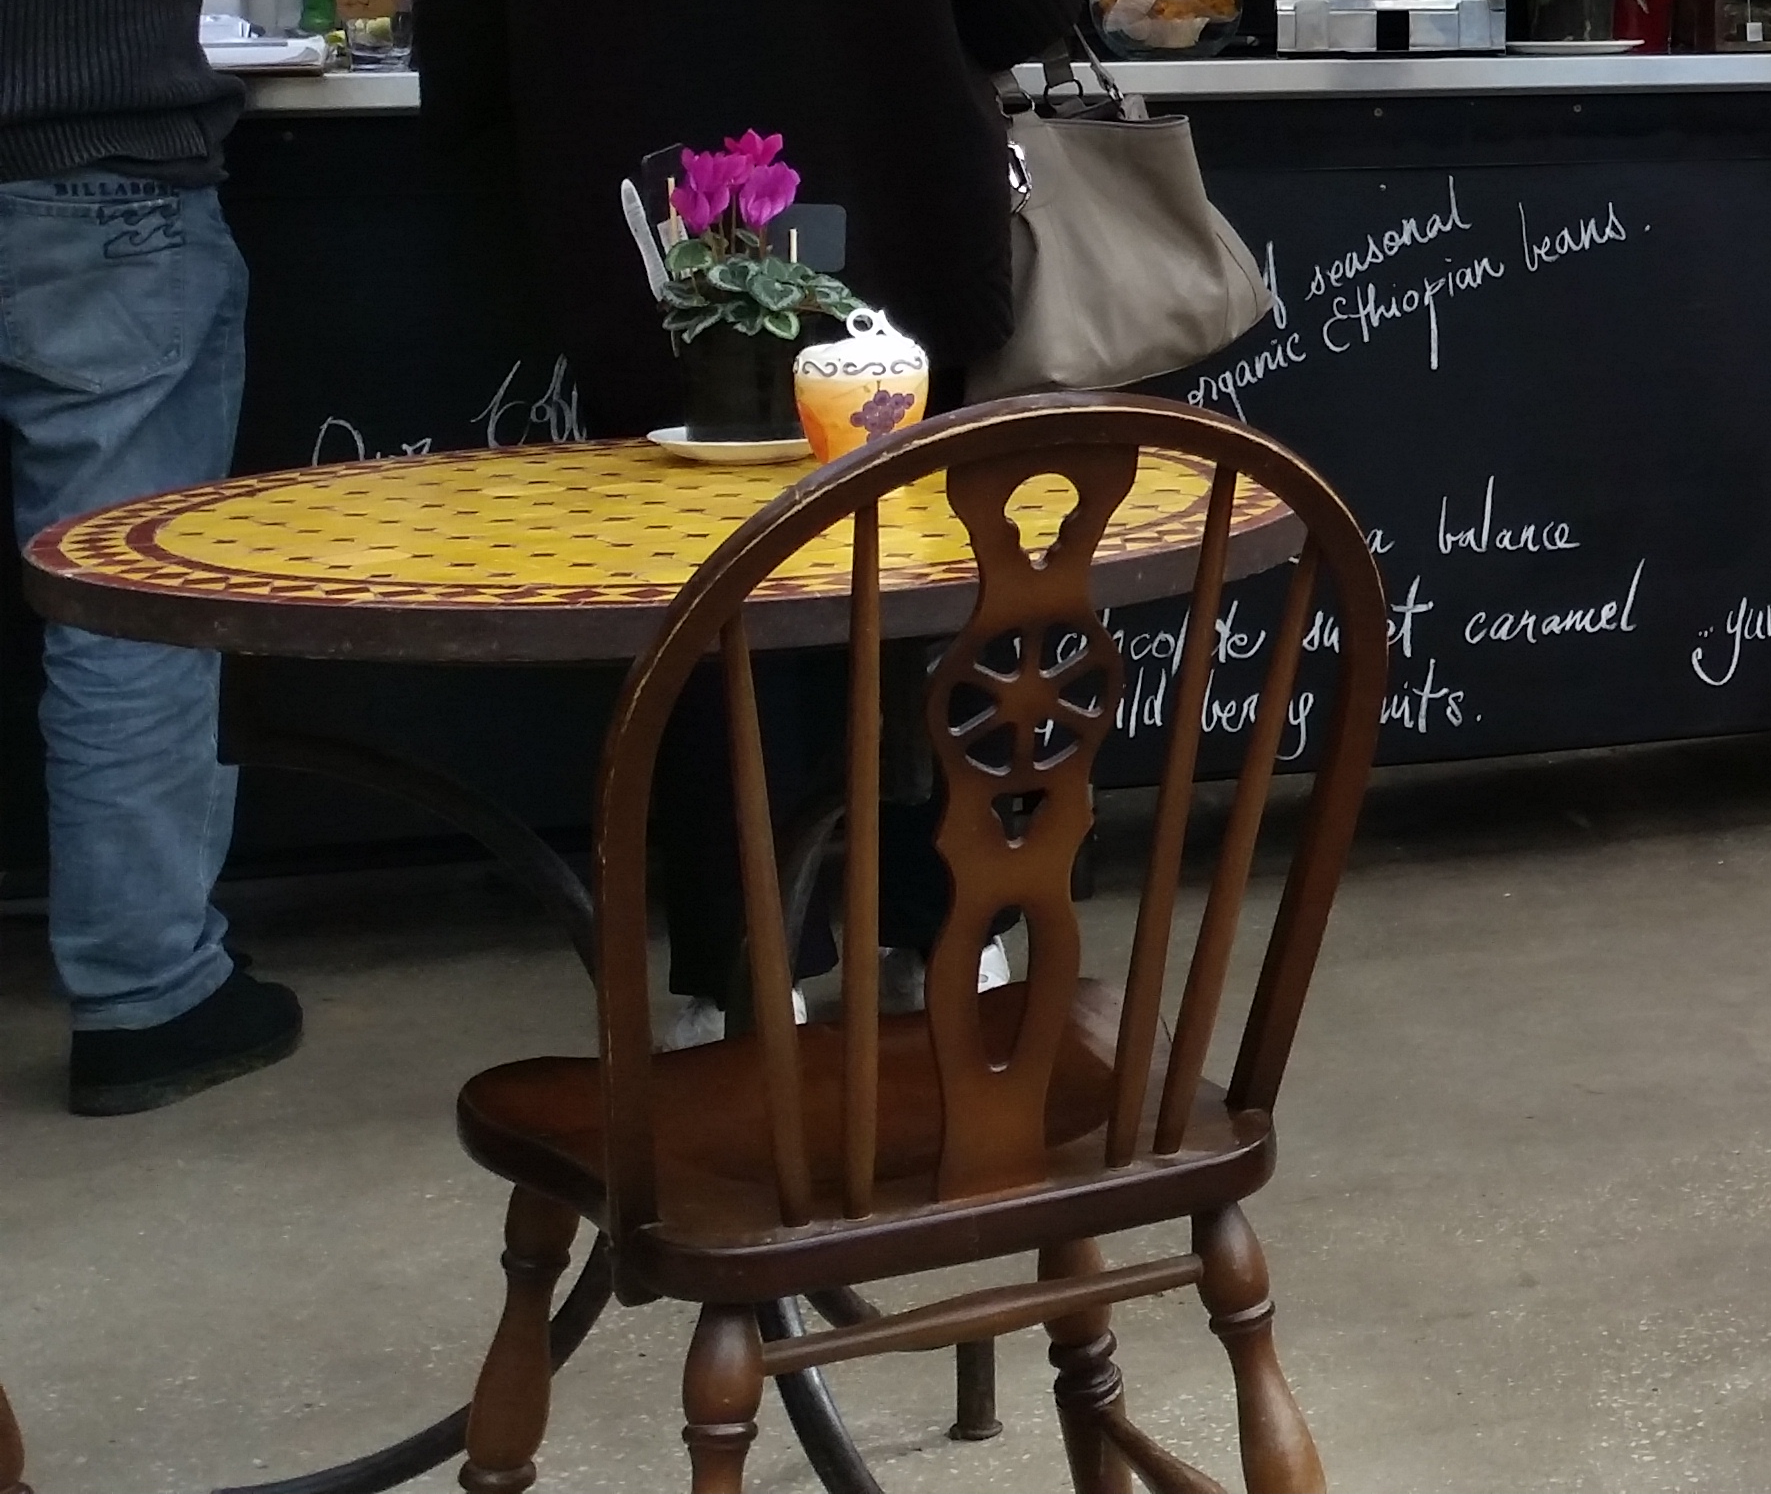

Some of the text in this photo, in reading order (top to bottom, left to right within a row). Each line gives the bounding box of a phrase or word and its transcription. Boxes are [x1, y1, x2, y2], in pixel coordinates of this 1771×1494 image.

[1304, 174, 1472, 301] seasonal
[1187, 334, 1307, 424] organic
[1322, 258, 1506, 370] Ethiopian
[1437, 474, 1581, 555] balance
[1464, 558, 1645, 646] caramel
